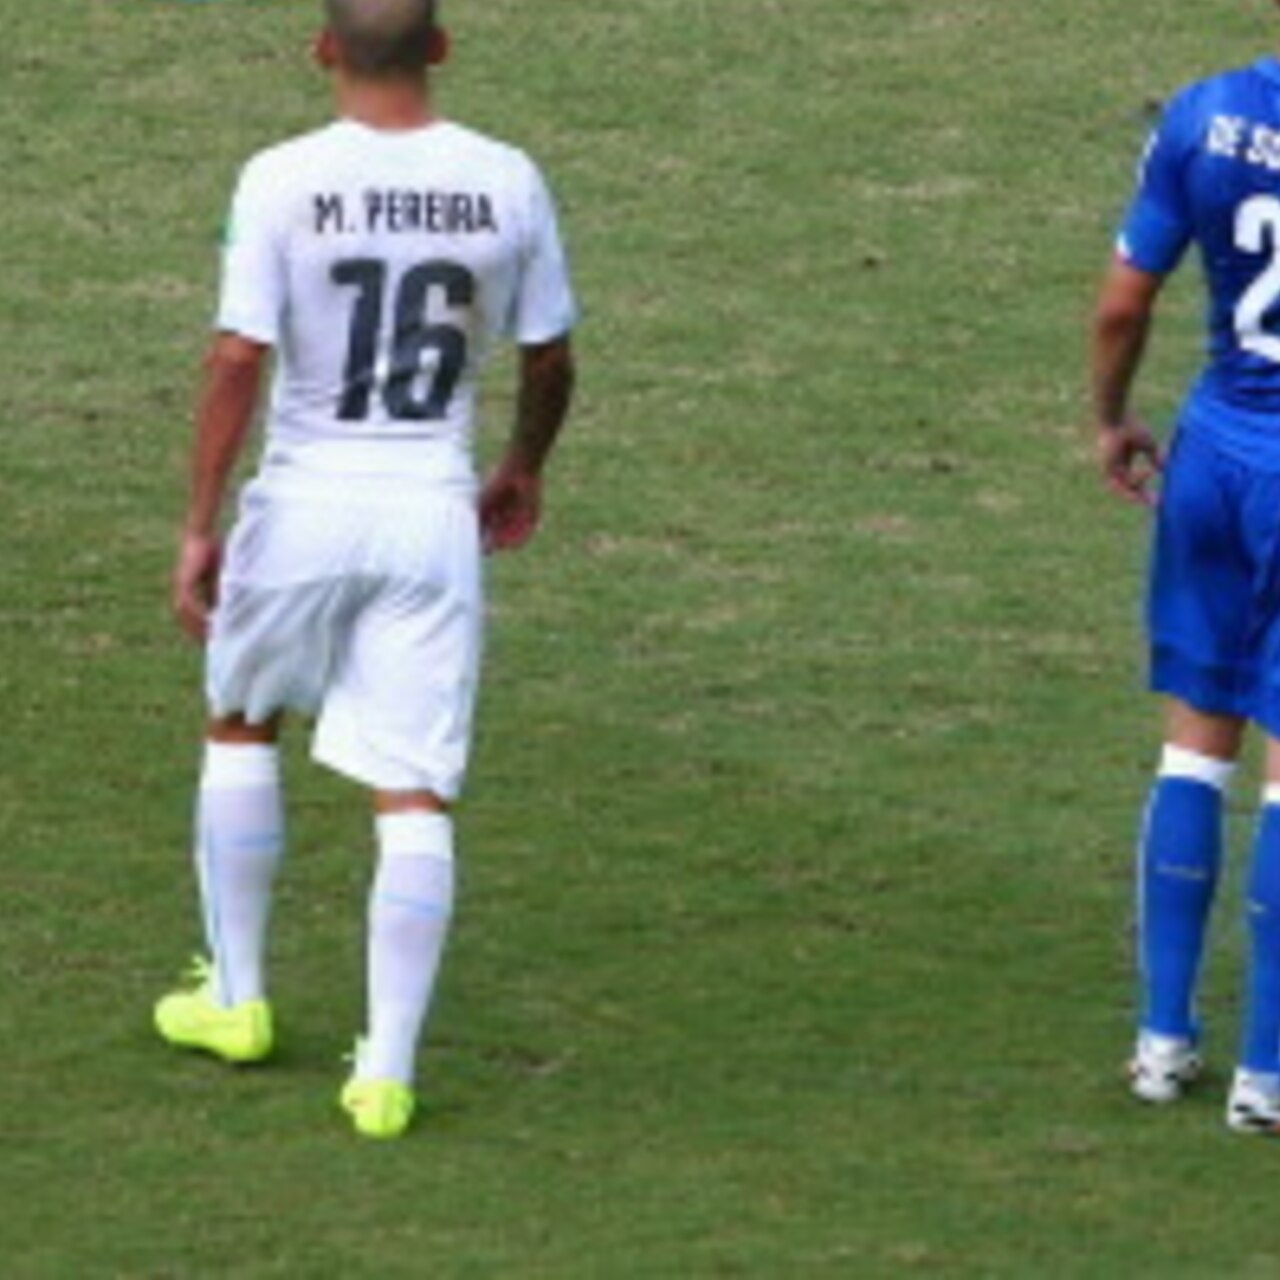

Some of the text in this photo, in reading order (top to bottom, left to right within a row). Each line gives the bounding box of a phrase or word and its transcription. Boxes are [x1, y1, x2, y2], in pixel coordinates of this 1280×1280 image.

[1206, 114, 1245, 158] DE
[313, 187, 499, 234] M. PEREIRA
[328, 256, 475, 422] 16
